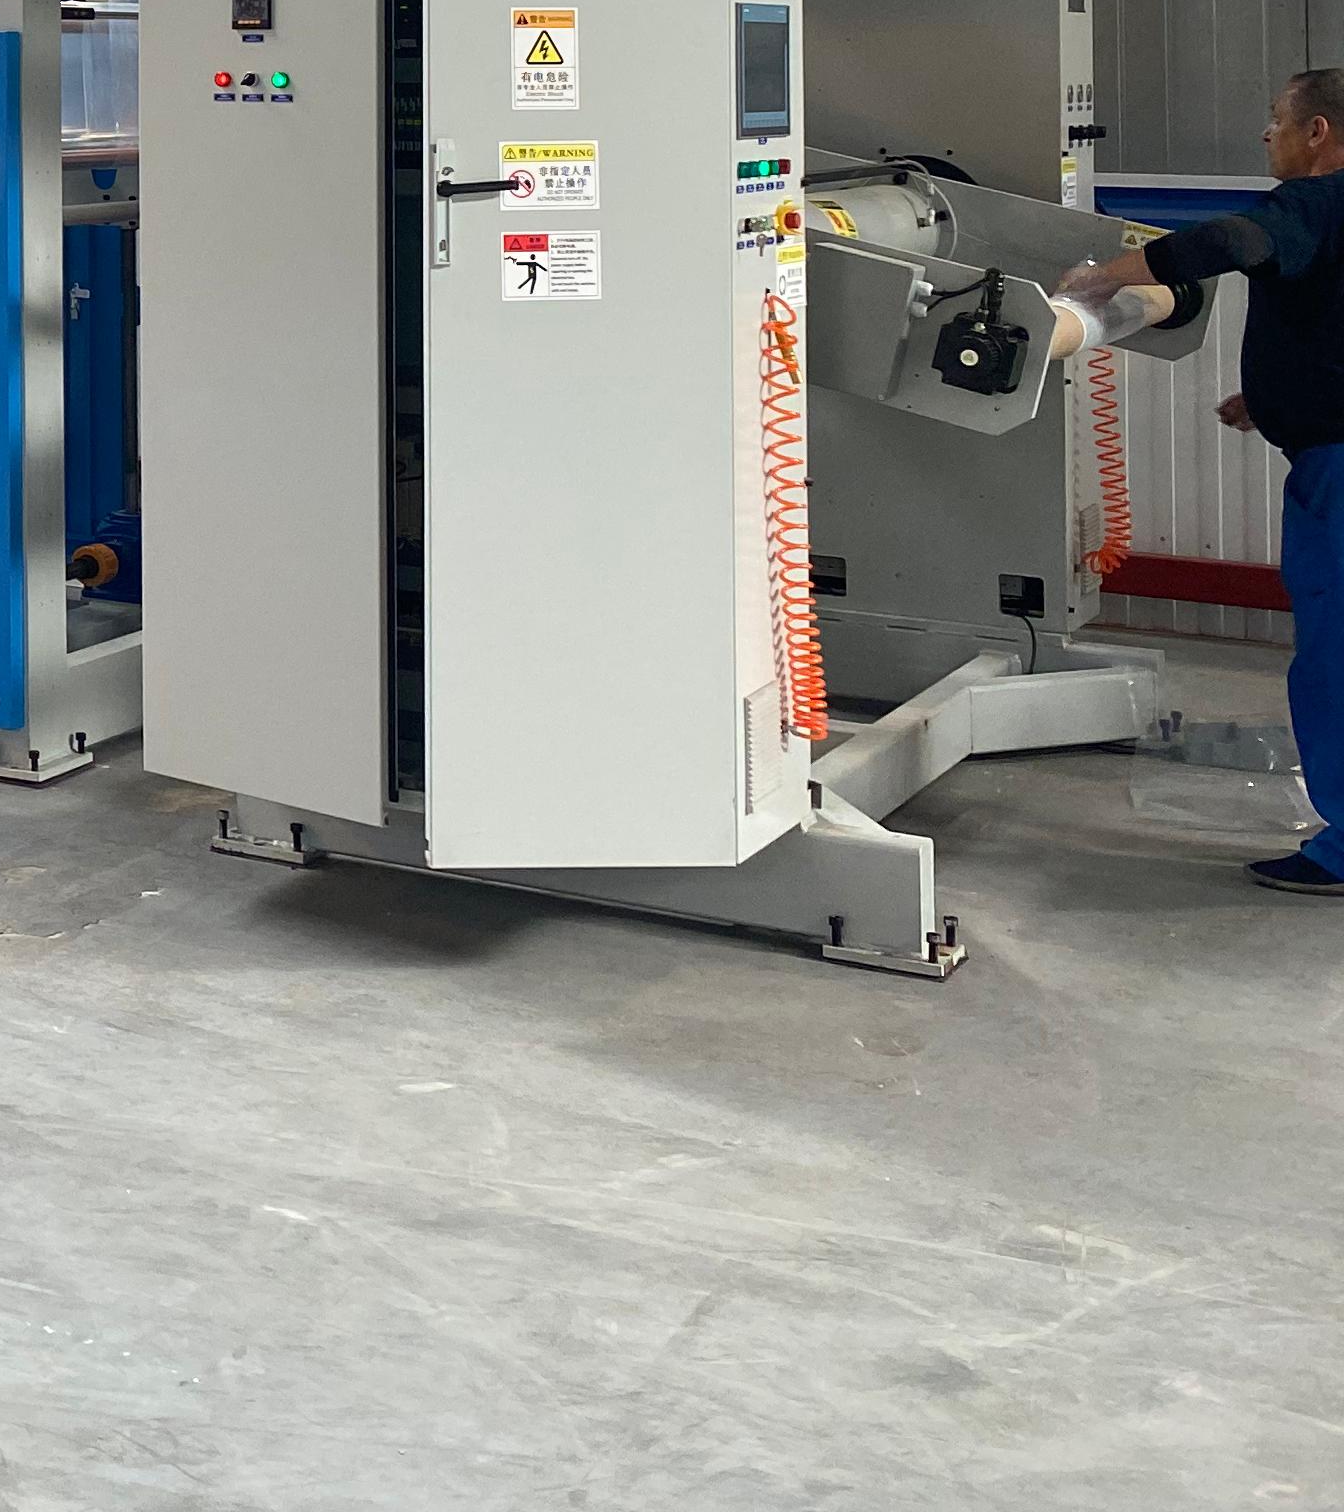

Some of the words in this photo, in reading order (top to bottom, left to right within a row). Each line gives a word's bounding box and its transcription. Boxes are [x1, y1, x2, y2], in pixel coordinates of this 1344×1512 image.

[521, 71, 569, 83] 有电危险
[539, 165, 592, 177] 非指定人员
[544, 178, 587, 189] 禁止操作
